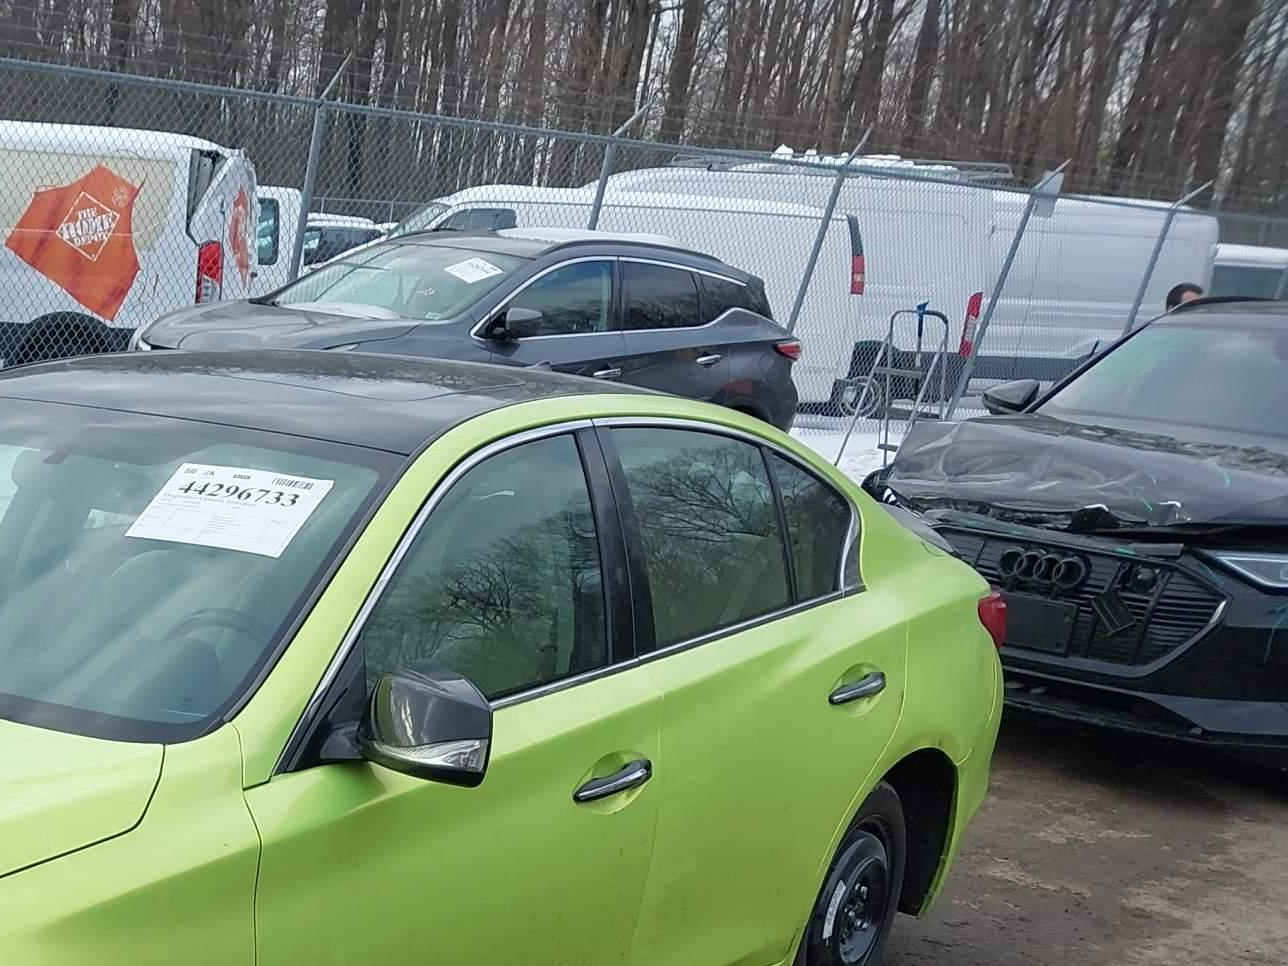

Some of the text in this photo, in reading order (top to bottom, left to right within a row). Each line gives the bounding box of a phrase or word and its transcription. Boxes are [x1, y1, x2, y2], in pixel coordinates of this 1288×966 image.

[76, 206, 98, 220] THE
[61, 212, 113, 240] HOME
[73, 229, 109, 247] DEPOT
[178, 480, 300, 507] 44296733
